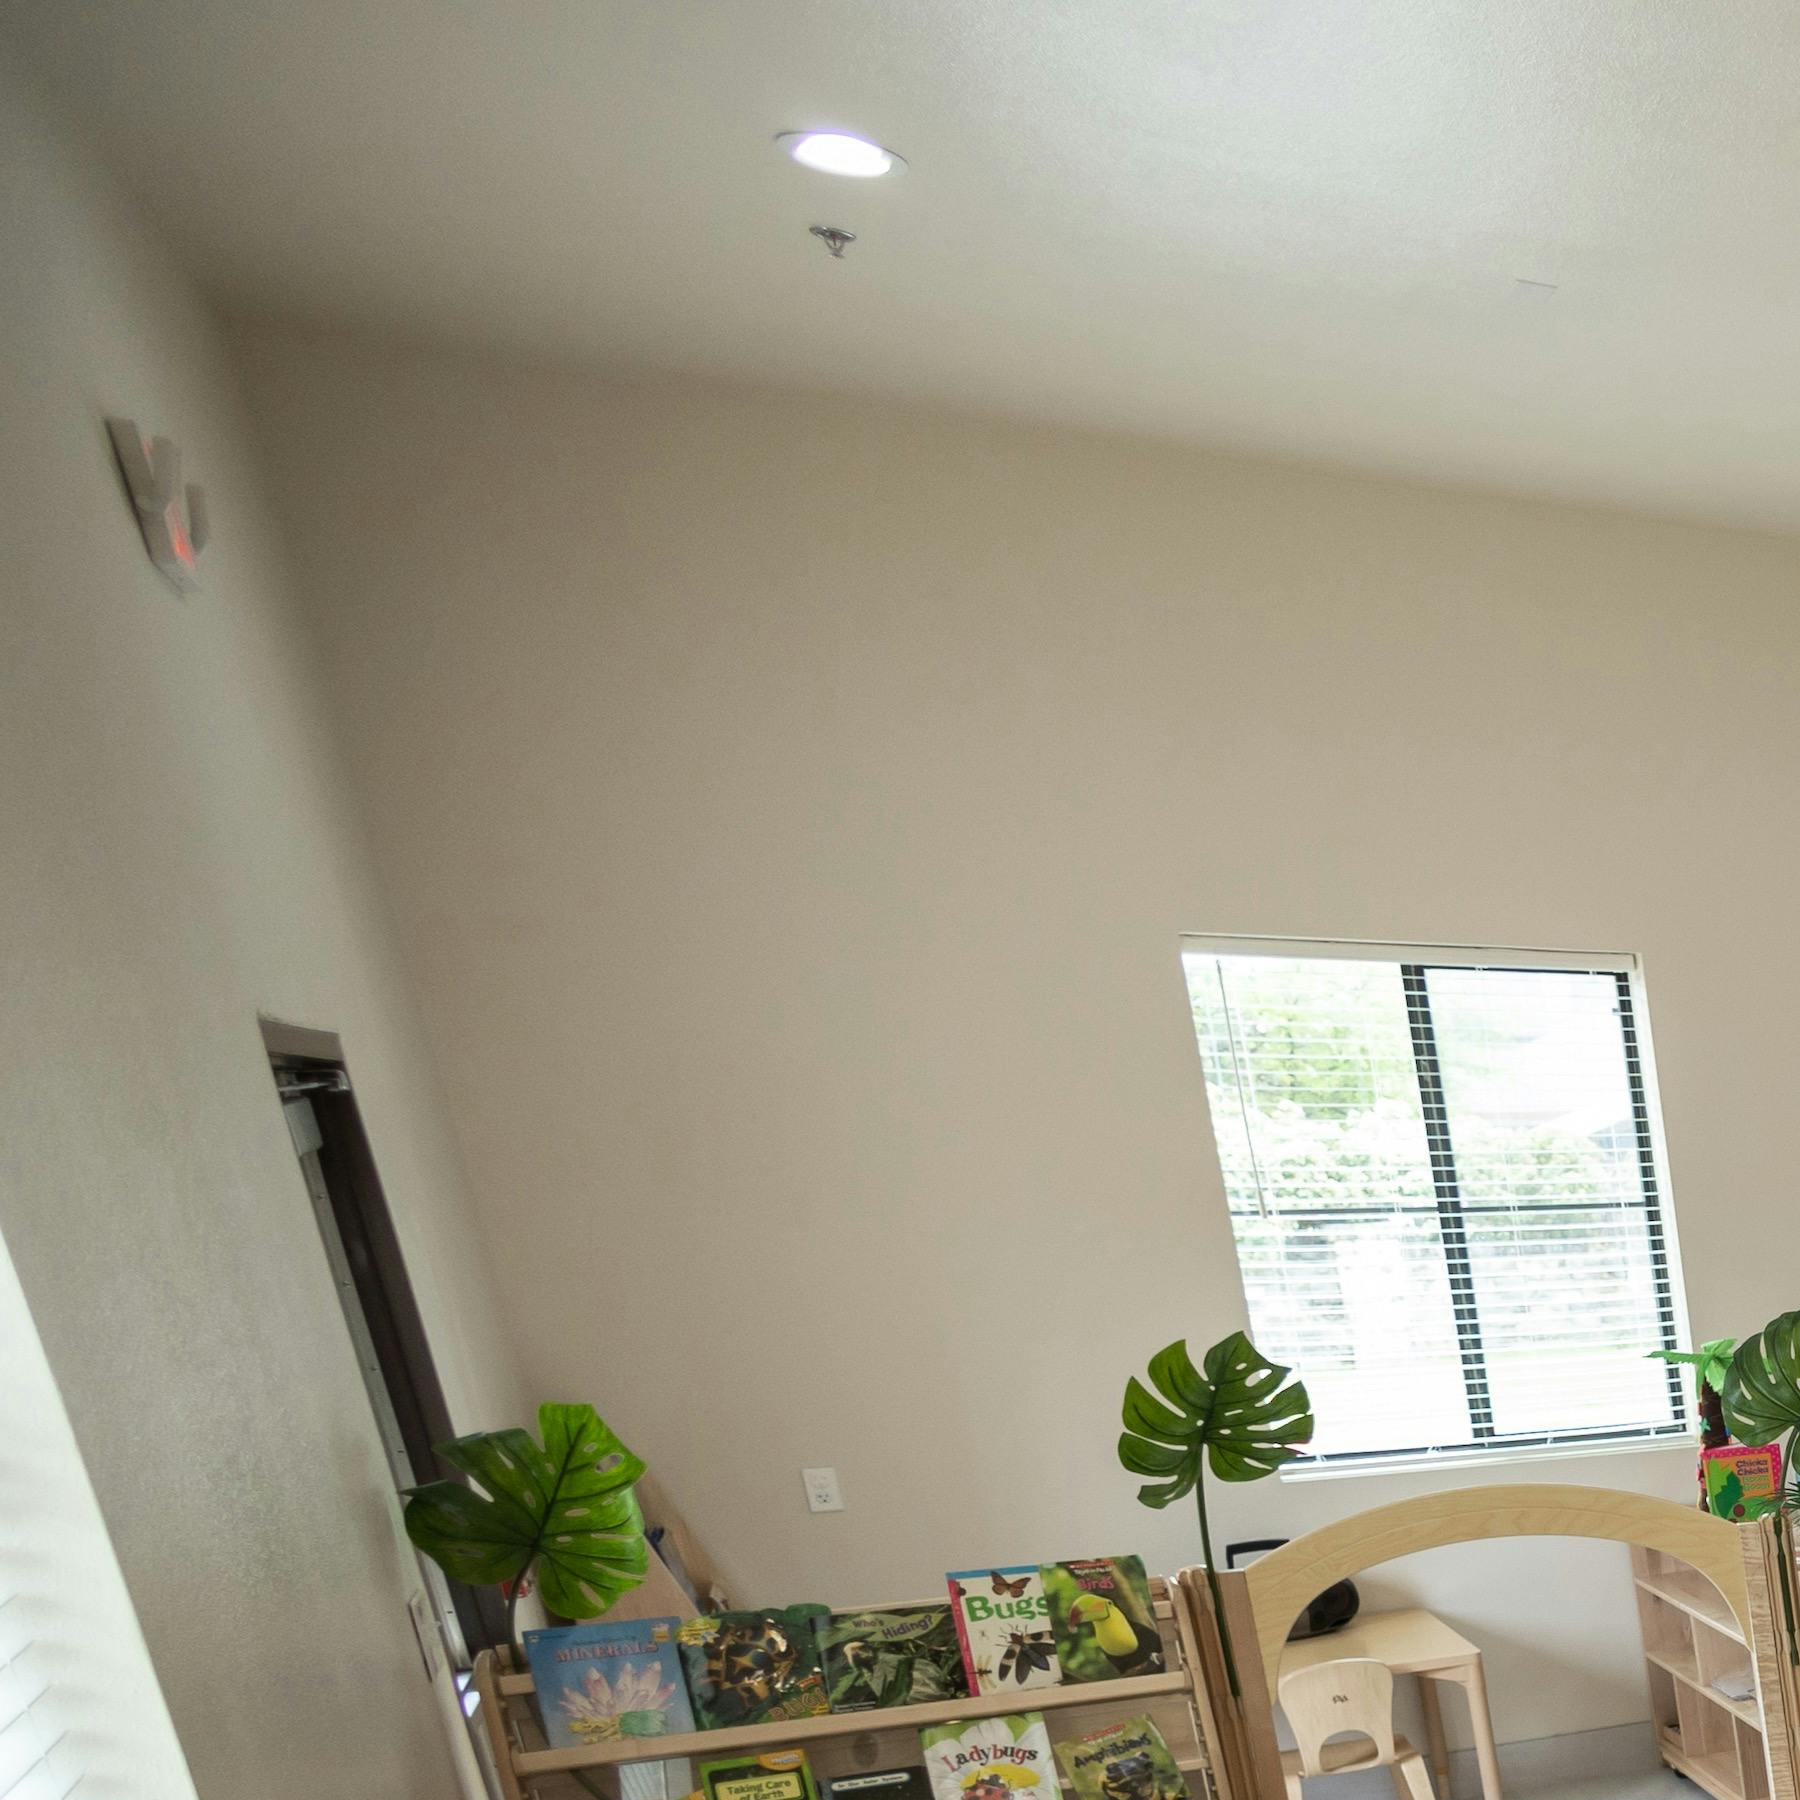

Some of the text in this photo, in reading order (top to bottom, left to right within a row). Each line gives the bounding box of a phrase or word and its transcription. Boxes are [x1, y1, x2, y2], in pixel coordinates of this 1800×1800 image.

[1736, 1459, 1768, 1468] Chicka
[1737, 1467, 1769, 1476] Chicka
[1077, 1575, 1116, 1591] Birds
[965, 1595, 1049, 1622] Bugs
[853, 1618, 885, 1629] Who's
[882, 1614, 934, 1639] Hiding?
[556, 1641, 659, 1662] MINERALS
[942, 1743, 1038, 1772] Ladybugs
[727, 1778, 791, 1796] Taking Care
[753, 1788, 785, 1800] Earth
